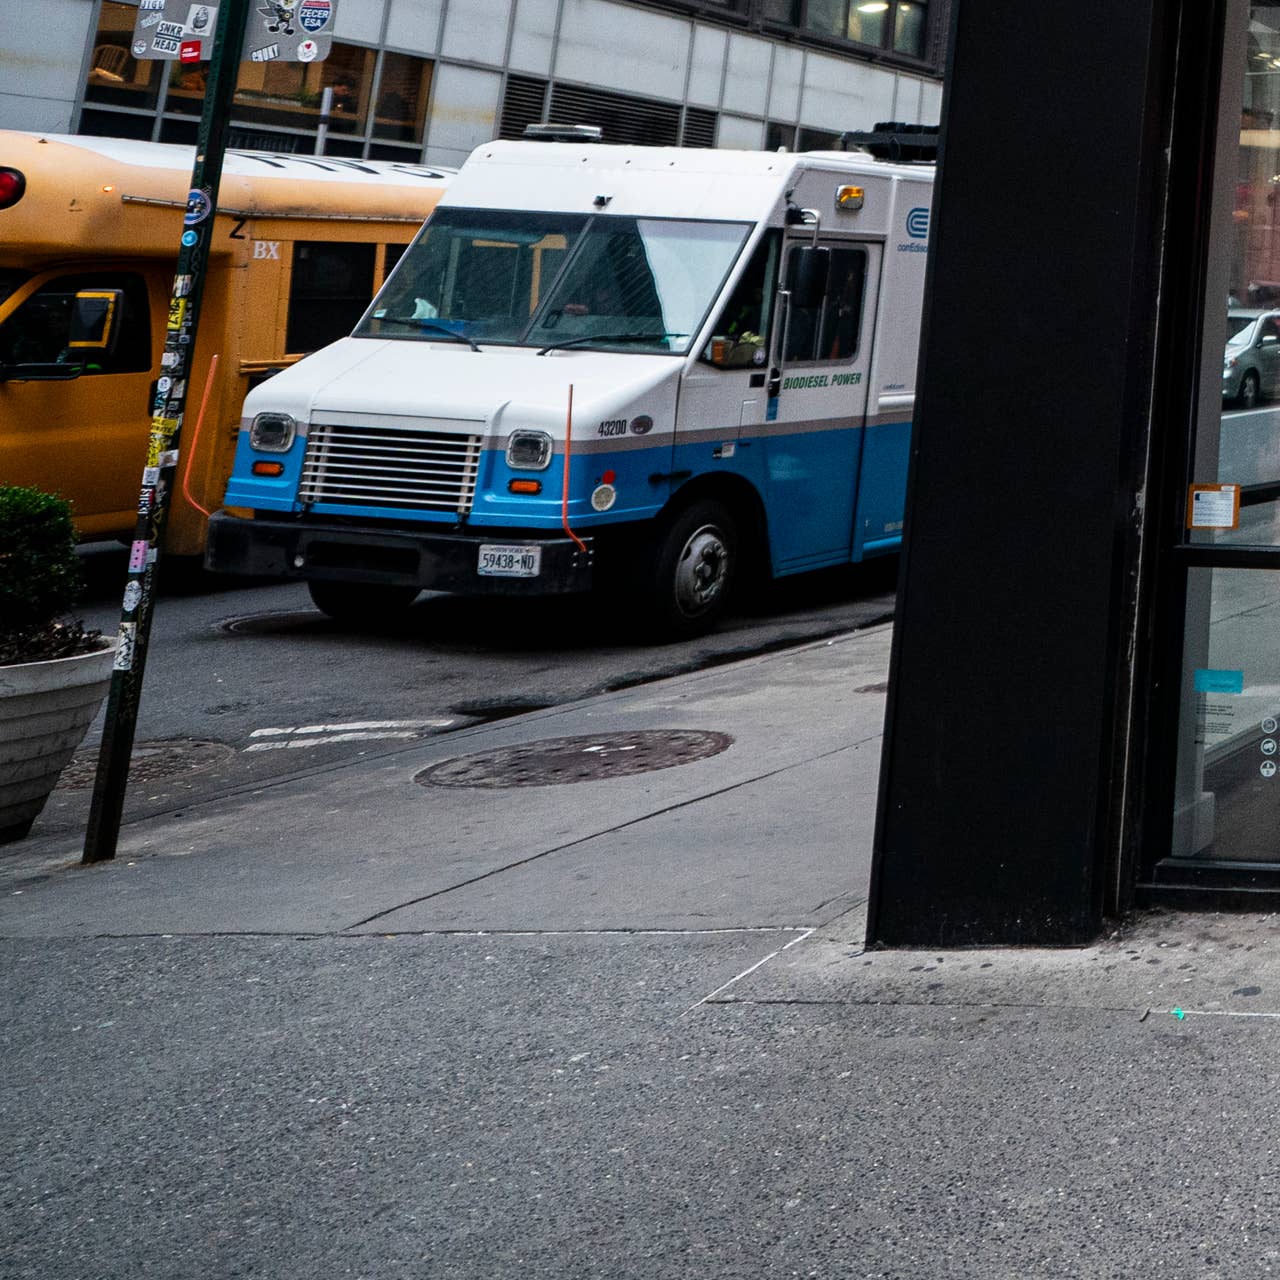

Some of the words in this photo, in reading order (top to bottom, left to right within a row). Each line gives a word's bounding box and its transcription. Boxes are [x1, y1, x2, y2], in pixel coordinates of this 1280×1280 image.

[153, 37, 179, 53] HEAD
[783, 376, 833, 390] BIODIESEL
[831, 373, 862, 386] POWER
[597, 419, 627, 437] 43200
